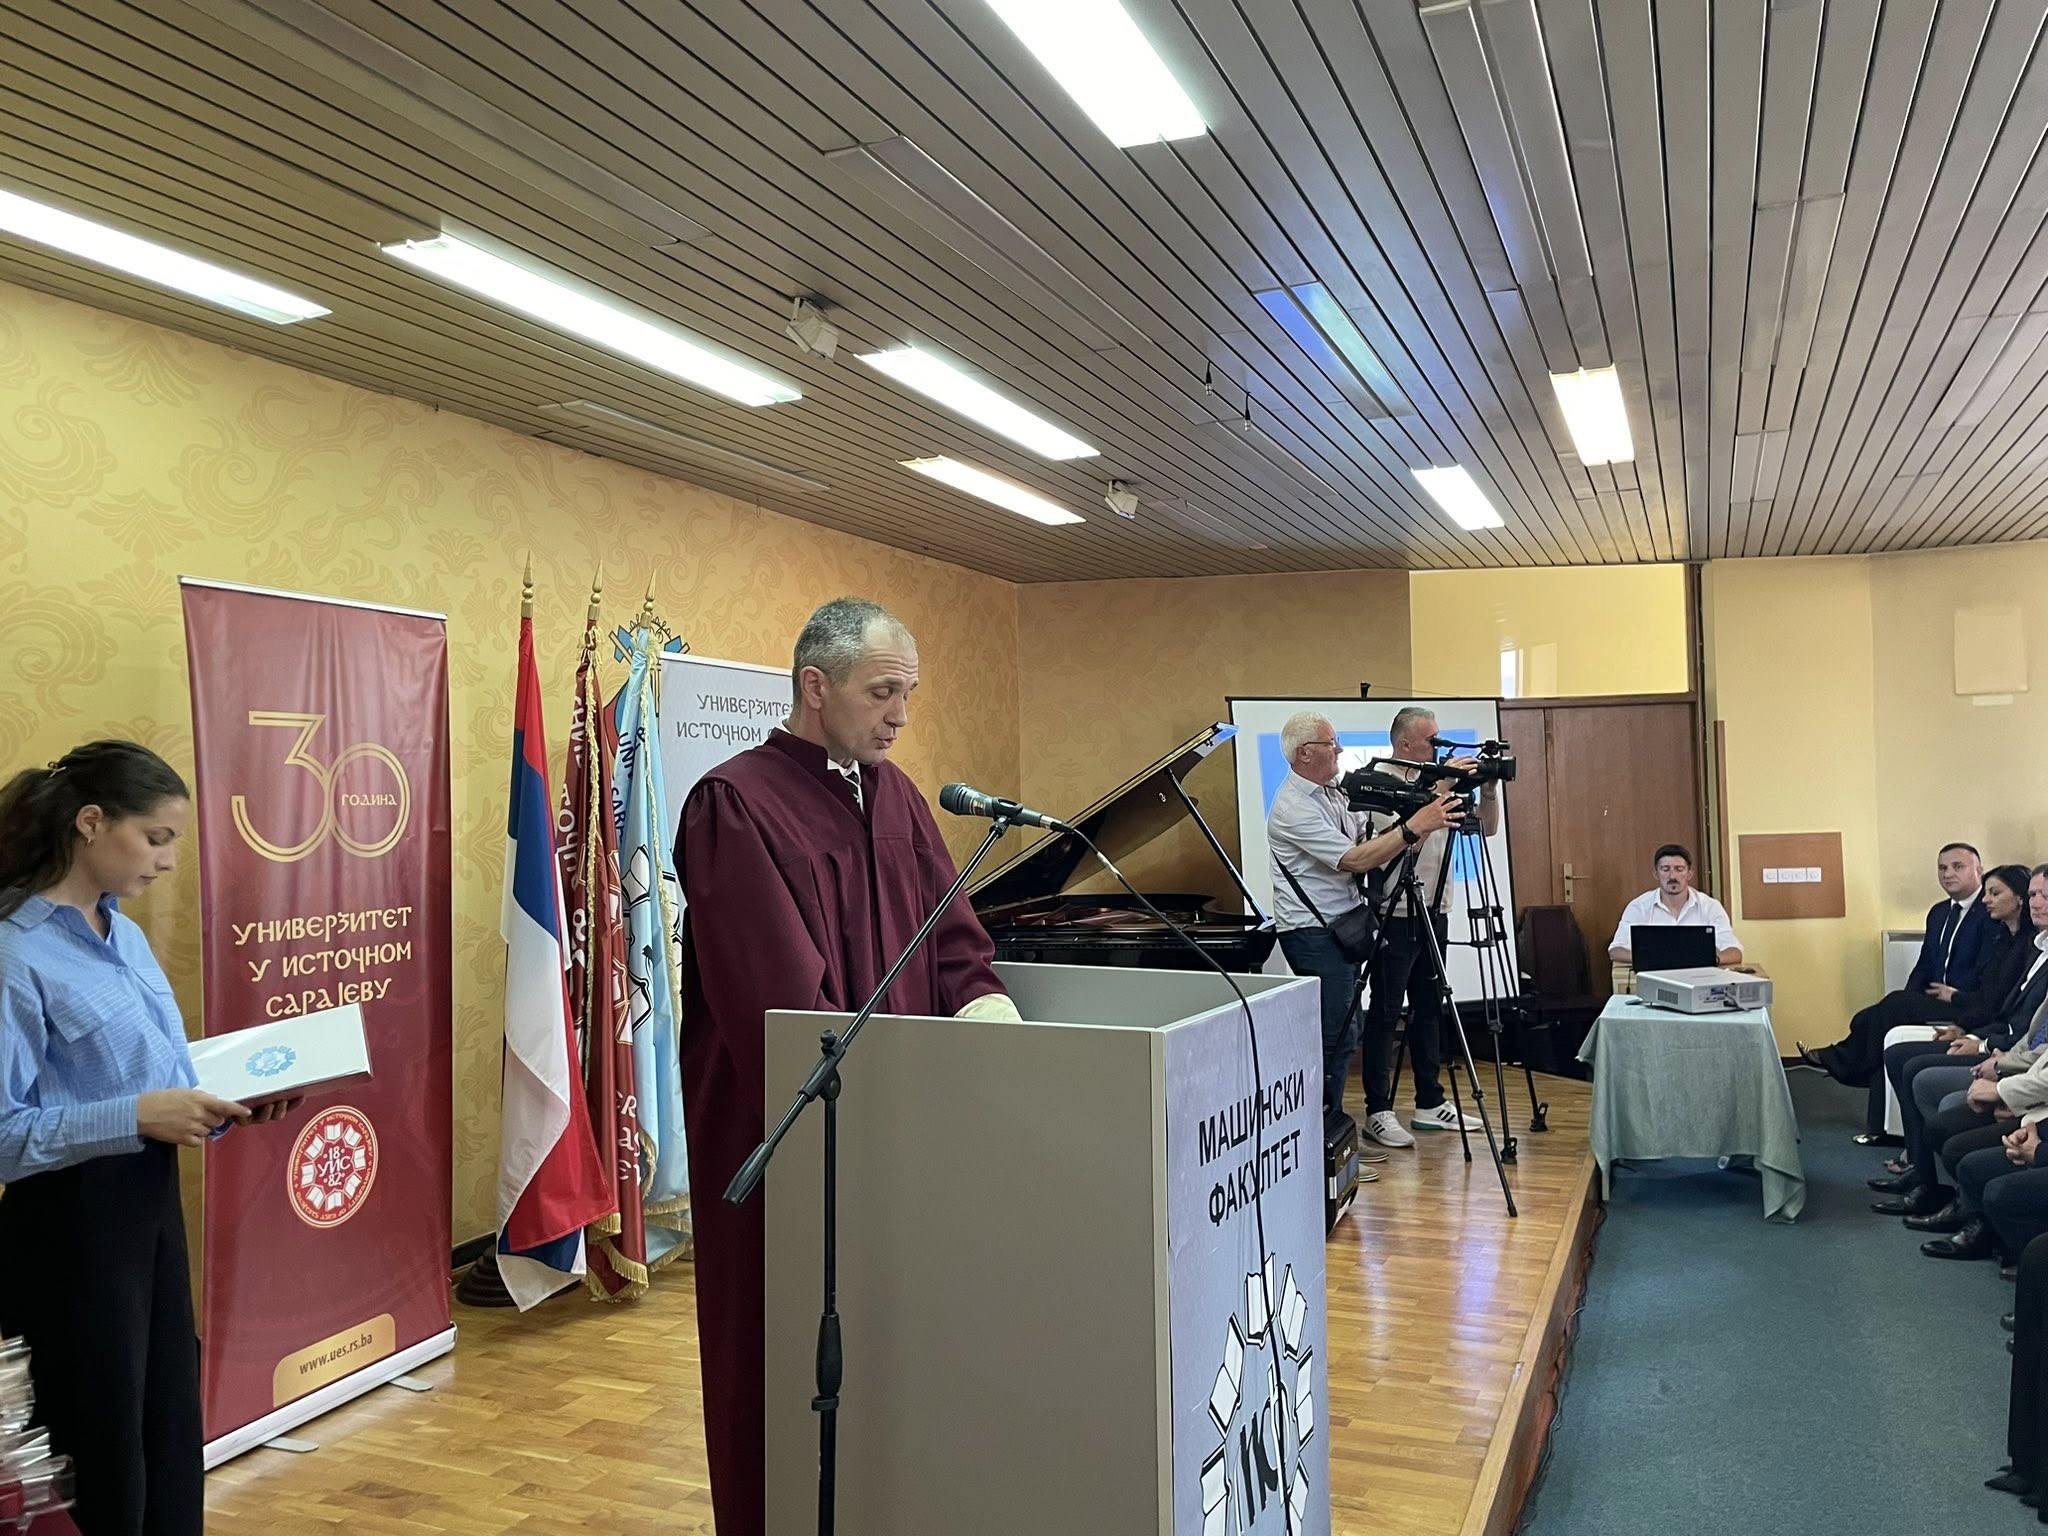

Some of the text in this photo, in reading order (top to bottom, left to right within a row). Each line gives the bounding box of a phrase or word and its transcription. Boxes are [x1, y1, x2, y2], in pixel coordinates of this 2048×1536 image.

[696, 693, 793, 719] УНИВЕРЗИТЕ
[676, 721, 762, 746] ИСТОЧНОМ
[231, 710, 411, 863] 30
[341, 793, 398, 807] ГОДИНА
[232, 906, 412, 946] УНИВЕРЗИТЕТ
[248, 941, 412, 983] У ИСТОЧНОМ
[265, 977, 392, 1018] САРАЈЕВУ
[1199, 1068, 1305, 1167] МАШИНСКИ
[328, 1146, 341, 1160] 18
[328, 1173, 342, 1187] 82
[1209, 1128, 1301, 1228] ФАКУЛТЕТ
[299, 1333, 373, 1375] www.ues.rs.ba
